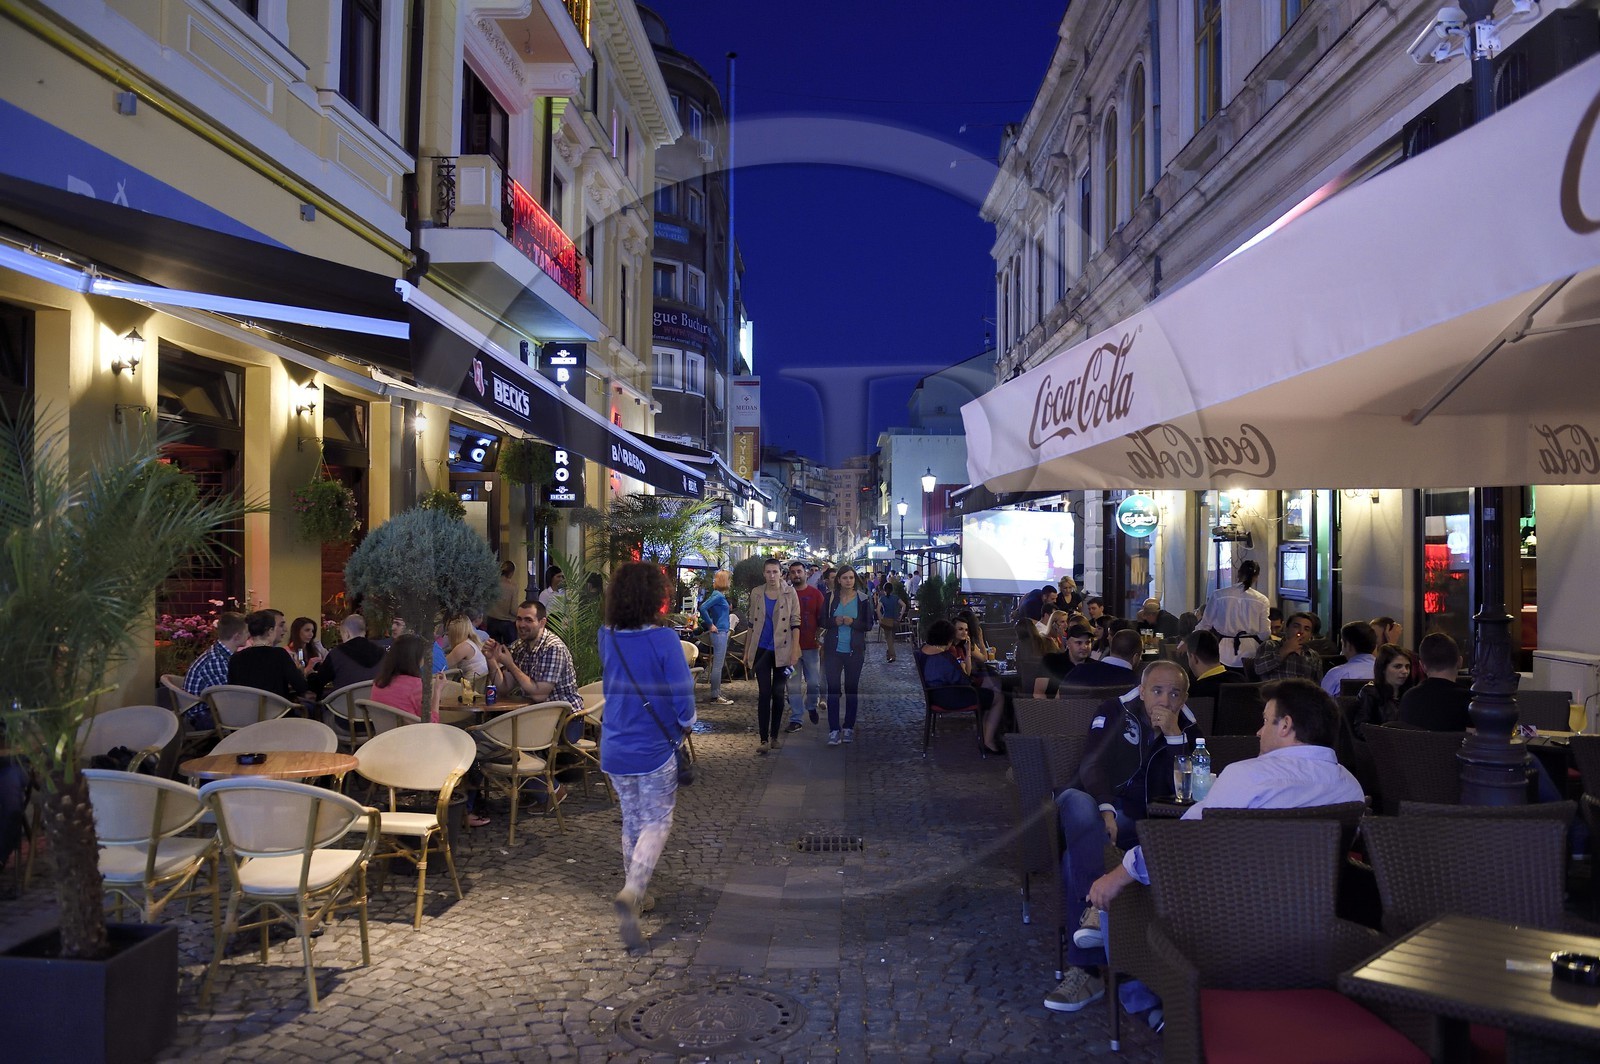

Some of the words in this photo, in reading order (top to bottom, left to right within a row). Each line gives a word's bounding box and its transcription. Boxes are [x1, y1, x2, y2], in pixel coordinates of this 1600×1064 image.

[493, 376, 530, 416] BECK'S
[1029, 327, 1137, 450] Coca-Cola
[739, 436, 748, 479] GYRO
